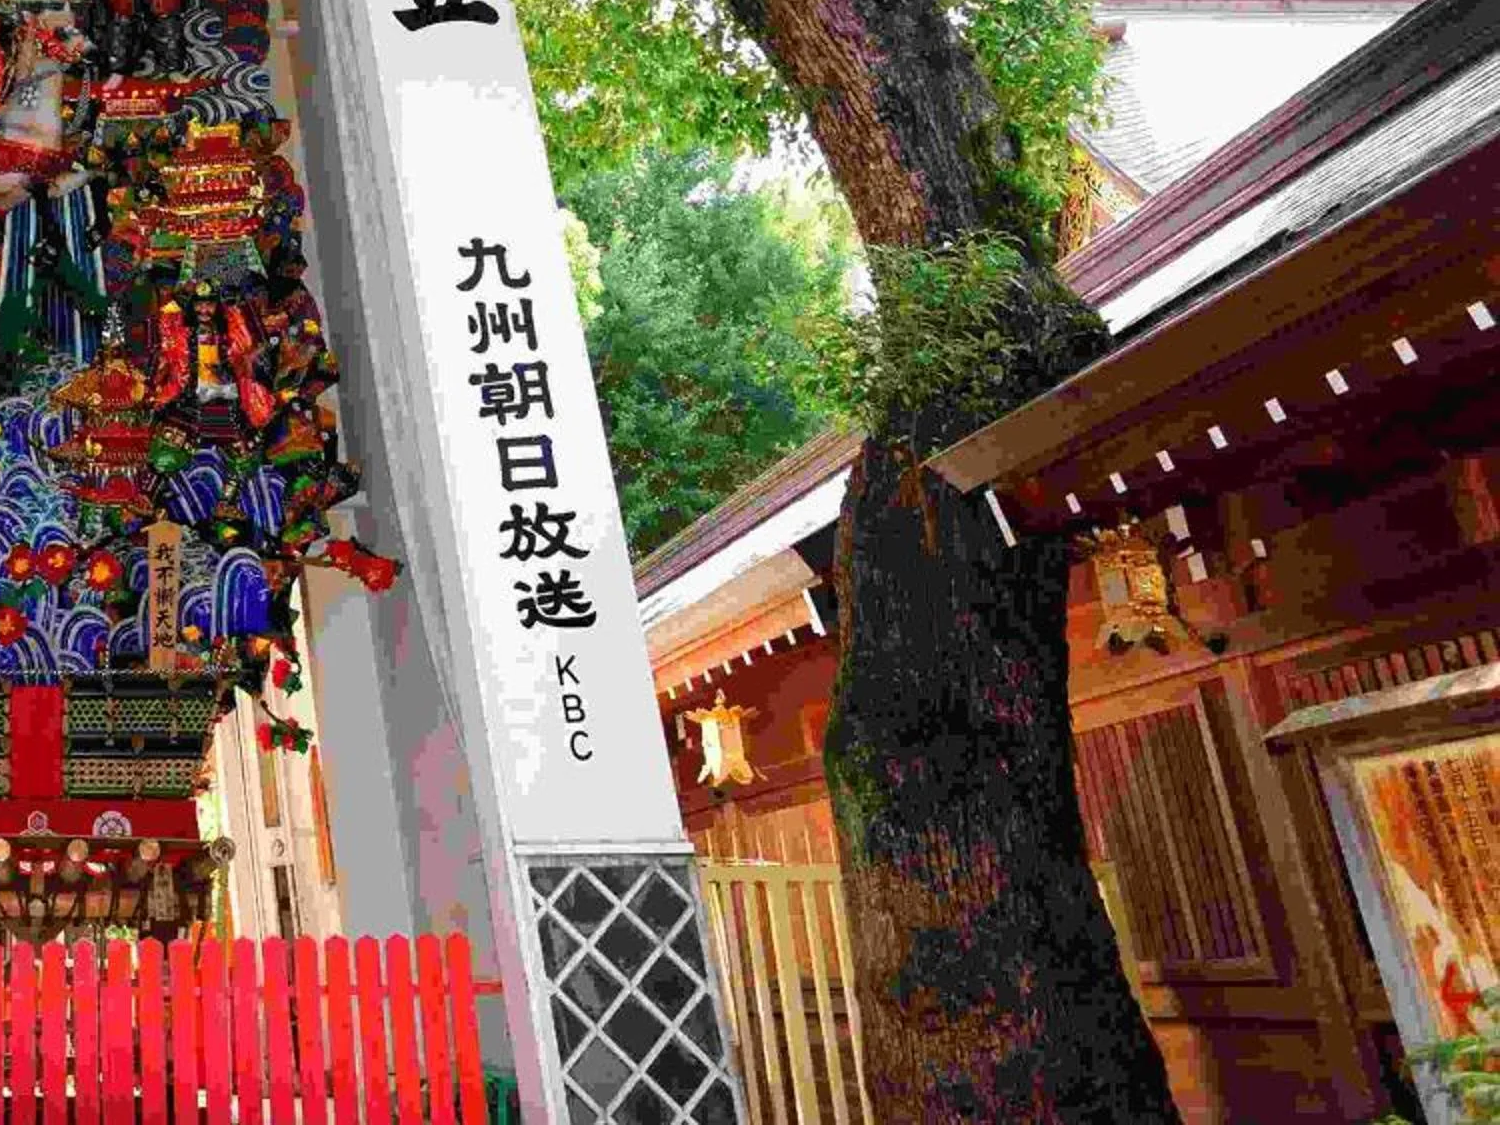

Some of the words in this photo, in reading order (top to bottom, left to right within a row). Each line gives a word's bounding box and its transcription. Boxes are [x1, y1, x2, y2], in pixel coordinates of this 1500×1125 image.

[455, 237, 597, 630] 九州朝日放送
[555, 654, 593, 762] KBC
